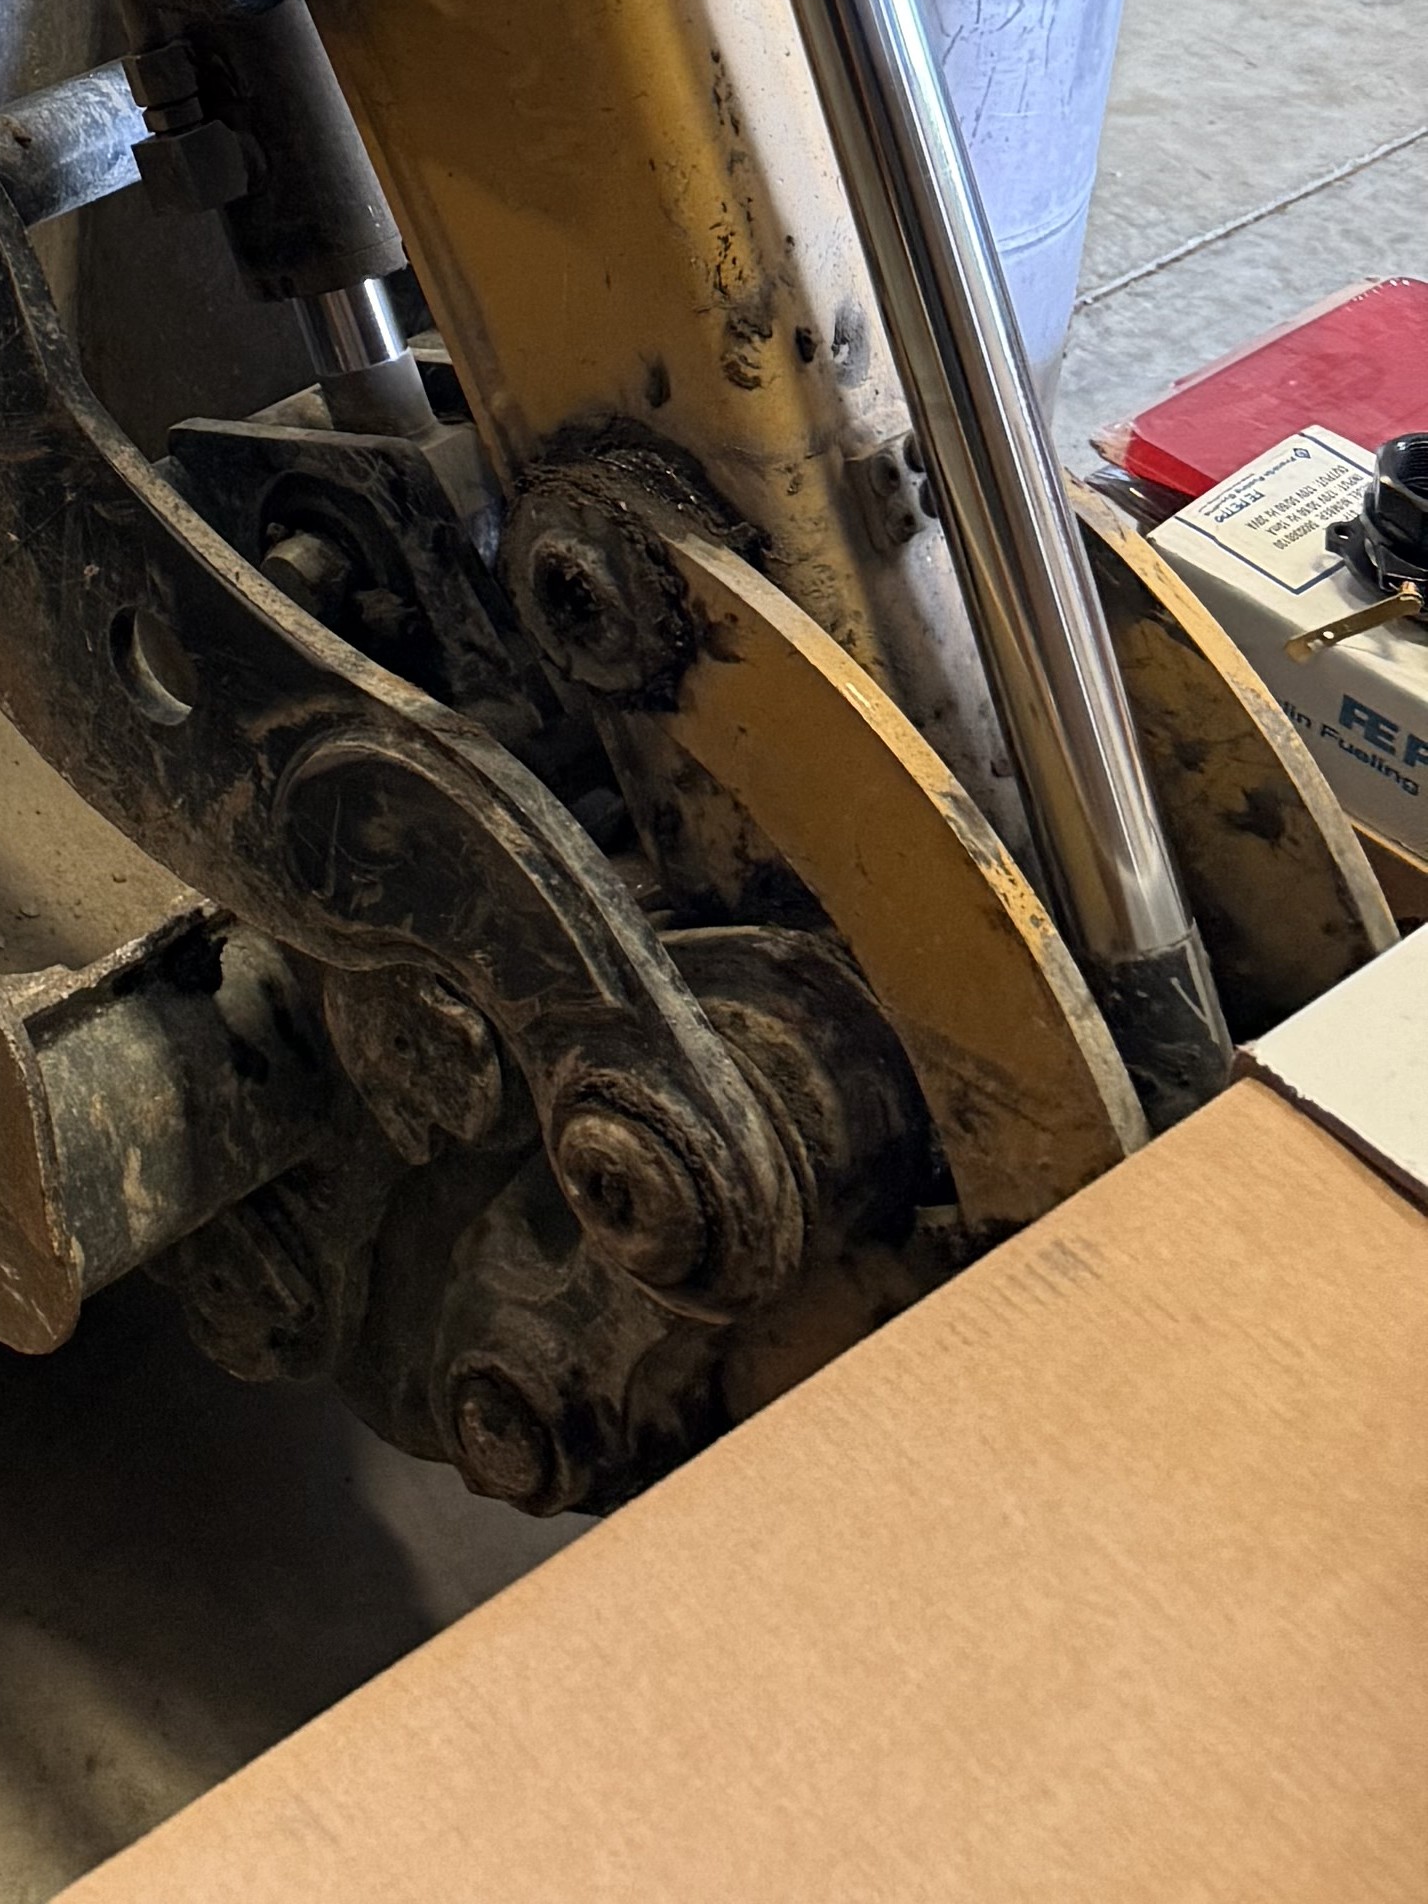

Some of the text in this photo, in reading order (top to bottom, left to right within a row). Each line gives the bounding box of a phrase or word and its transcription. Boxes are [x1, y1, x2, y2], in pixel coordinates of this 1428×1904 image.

[1247, 489, 1266, 503] FE
[1338, 693, 1401, 756] FE
[1320, 723, 1419, 797] Fueling
